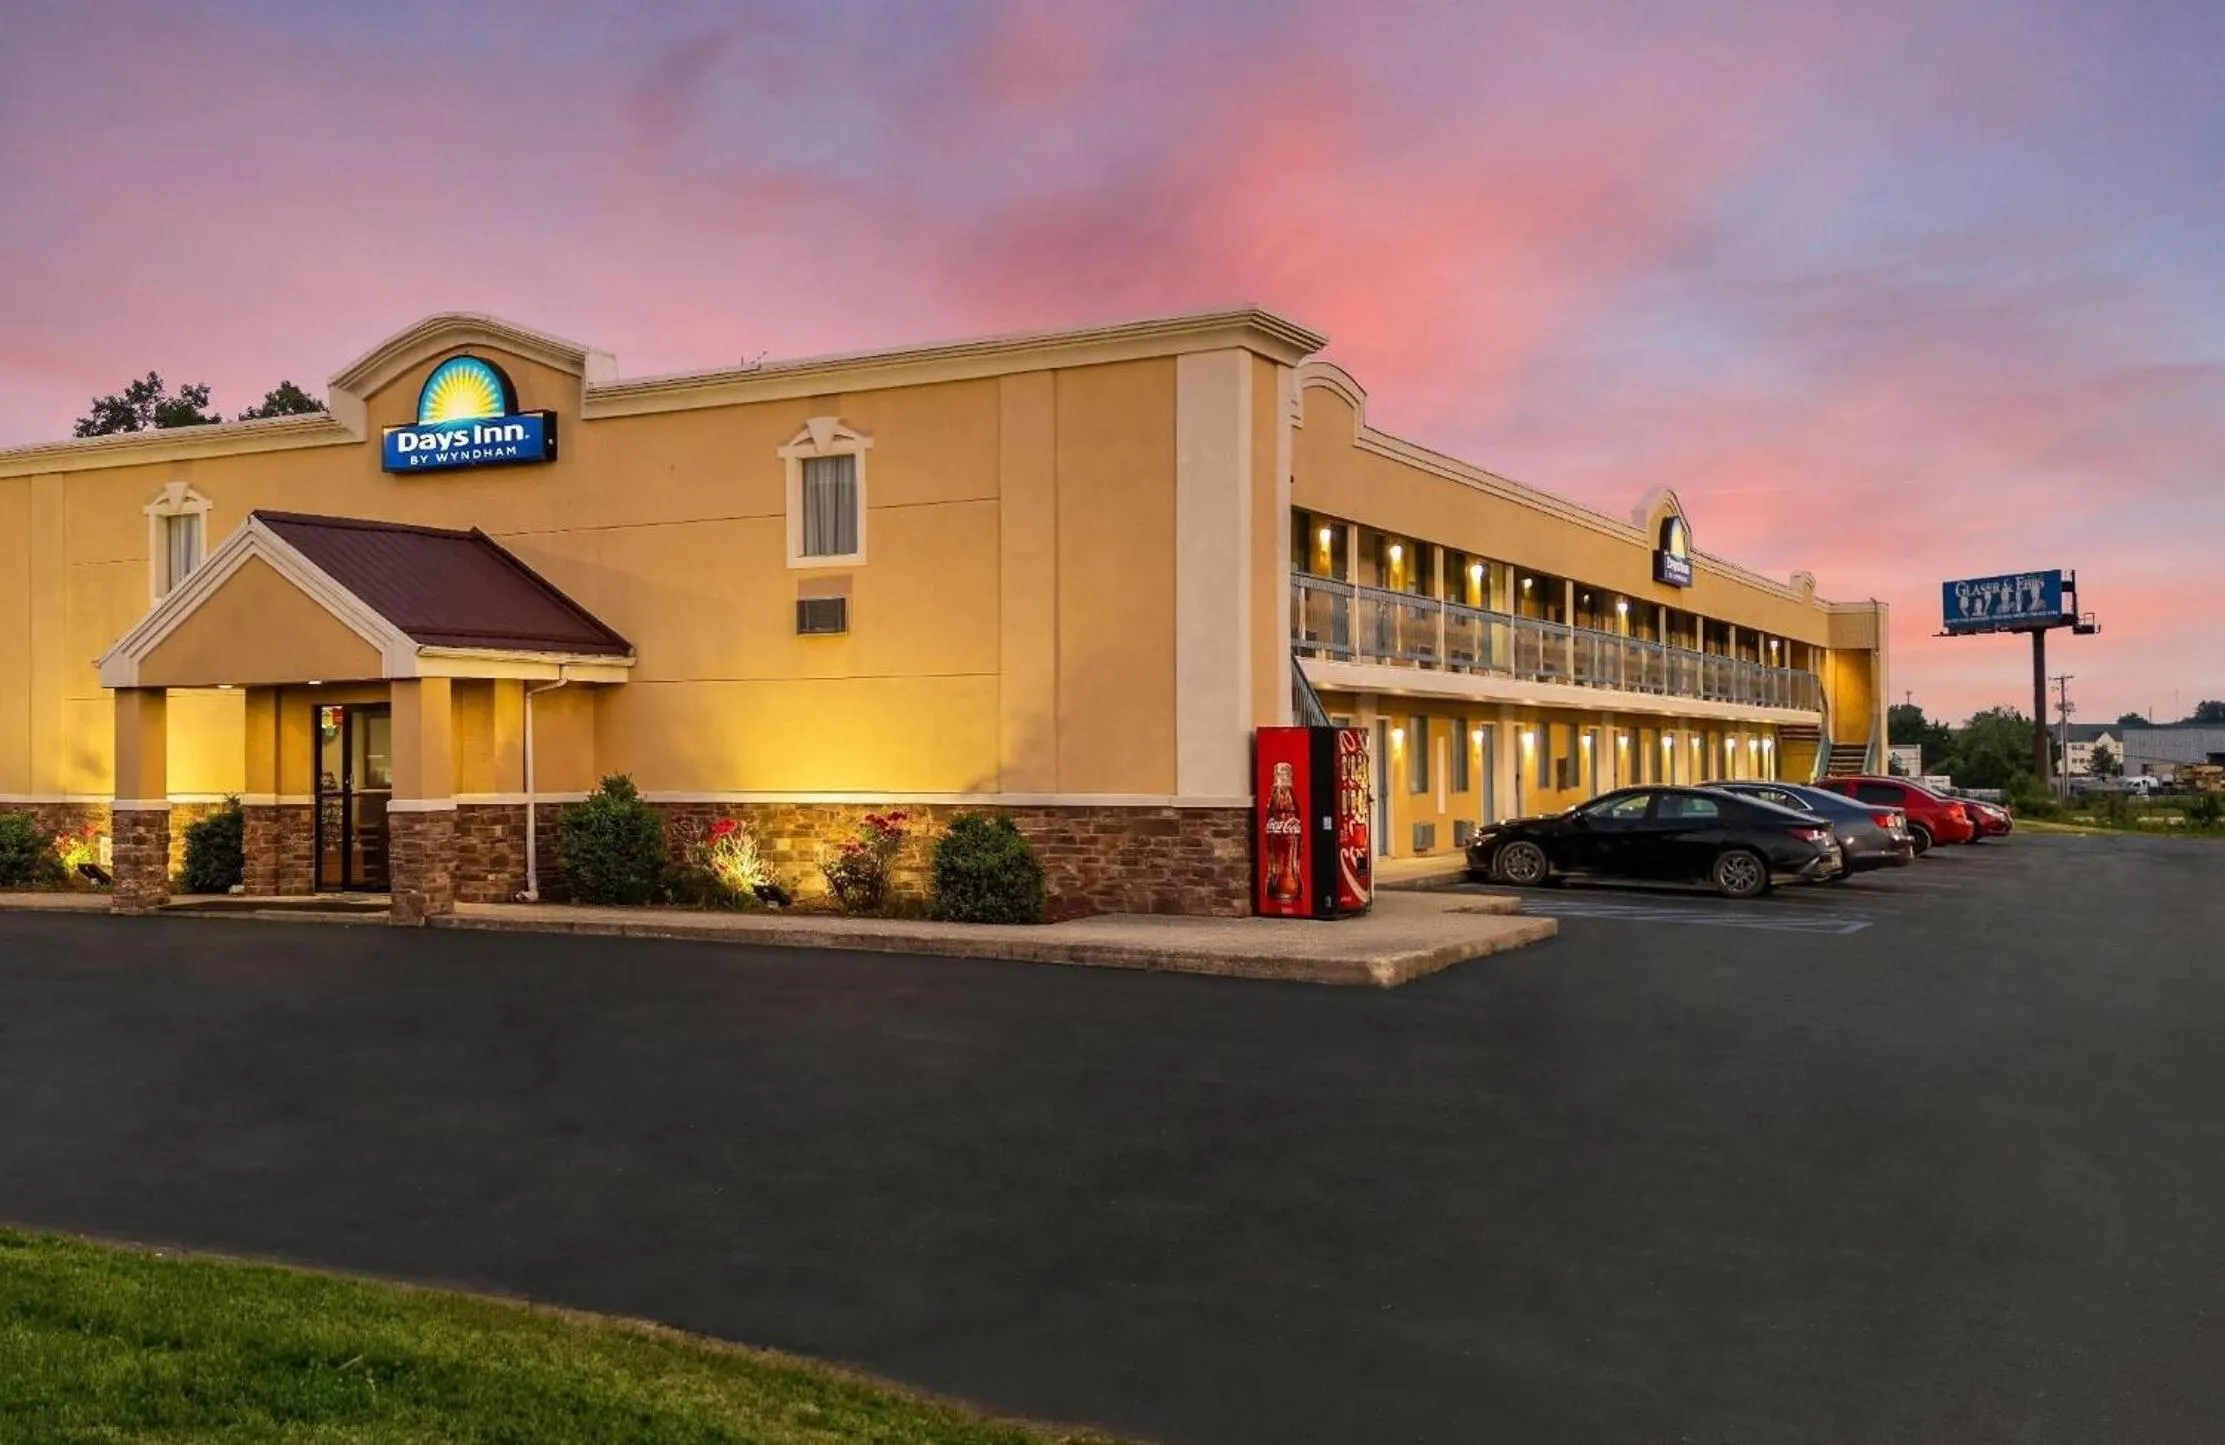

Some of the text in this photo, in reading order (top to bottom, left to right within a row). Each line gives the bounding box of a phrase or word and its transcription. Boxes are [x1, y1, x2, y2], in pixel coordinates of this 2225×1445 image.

[397, 423, 524, 452] Days Inn
[410, 446, 517, 465] BY WYNDHAM
